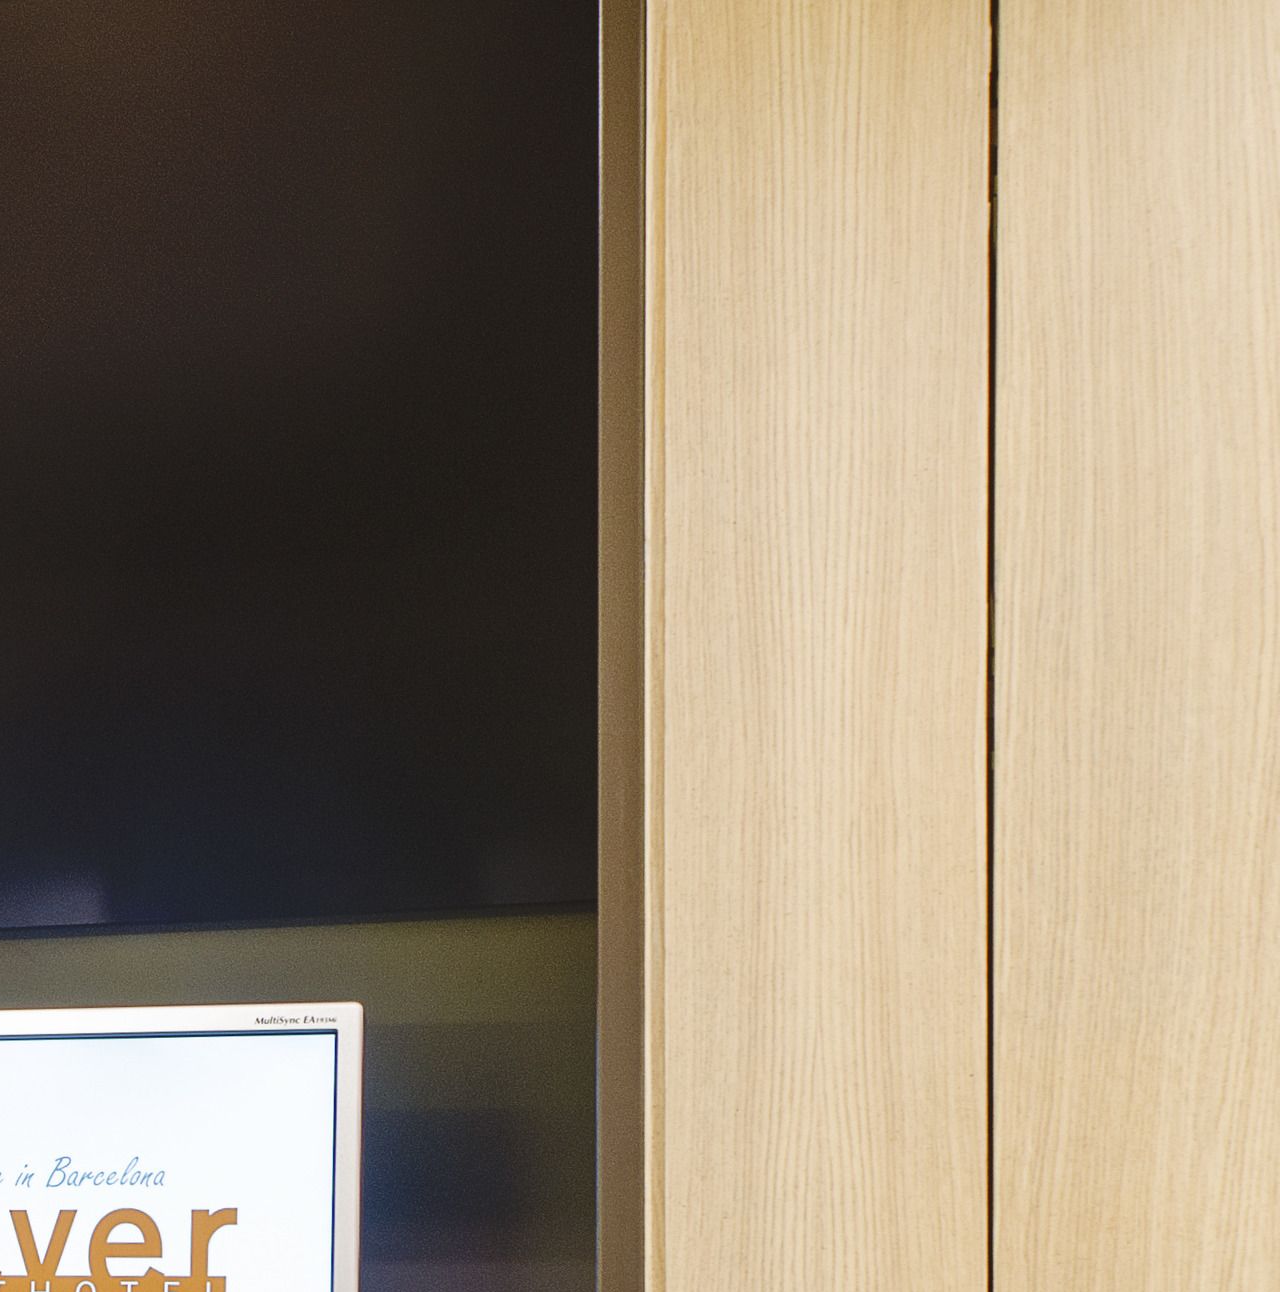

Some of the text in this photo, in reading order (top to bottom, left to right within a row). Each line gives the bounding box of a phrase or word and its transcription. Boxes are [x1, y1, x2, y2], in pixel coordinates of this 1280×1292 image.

[254, 1016, 301, 1026] MultiSync
[14, 1163, 35, 1188] in
[45, 1156, 165, 1187] Barcelona
